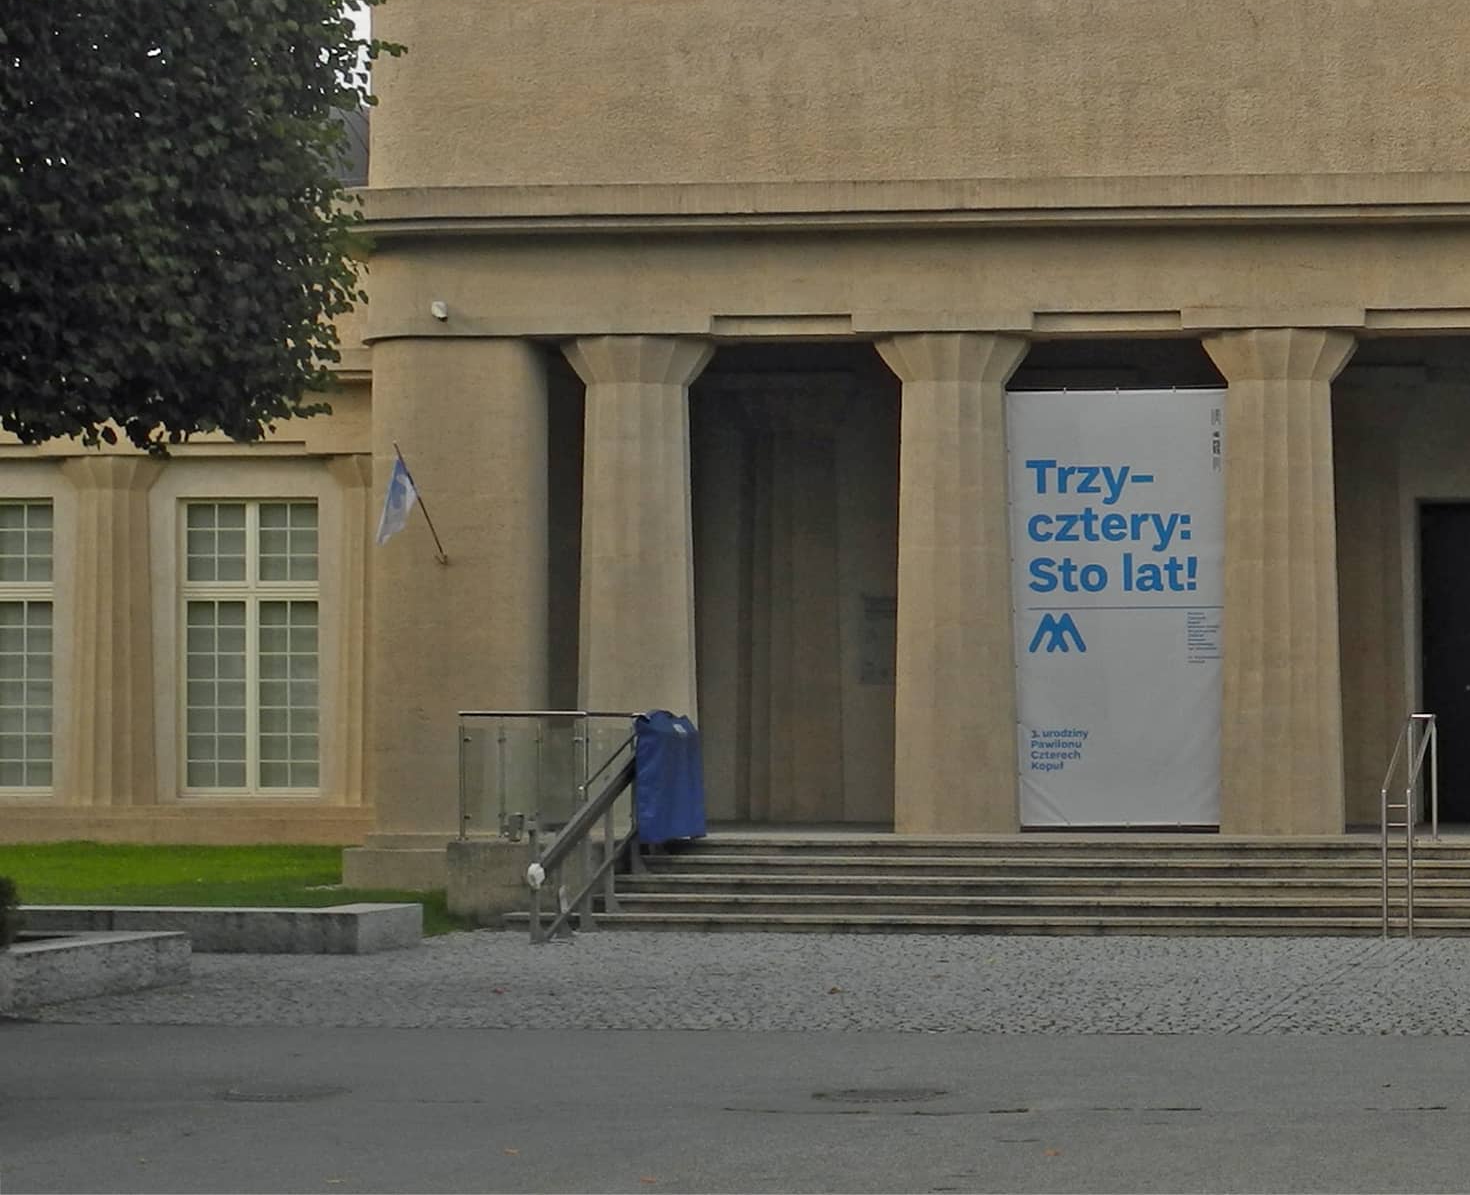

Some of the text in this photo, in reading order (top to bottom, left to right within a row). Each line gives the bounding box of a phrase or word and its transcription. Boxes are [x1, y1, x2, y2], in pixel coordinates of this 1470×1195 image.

[1025, 459, 1154, 505] Trzy-
[1027, 507, 1191, 552] cztery:
[1028, 552, 1197, 593] Sto lat!
[1031, 739, 1082, 749] Pawilonu
[1042, 728, 1088, 741] urodziny
[1031, 750, 1081, 760] Czterech
